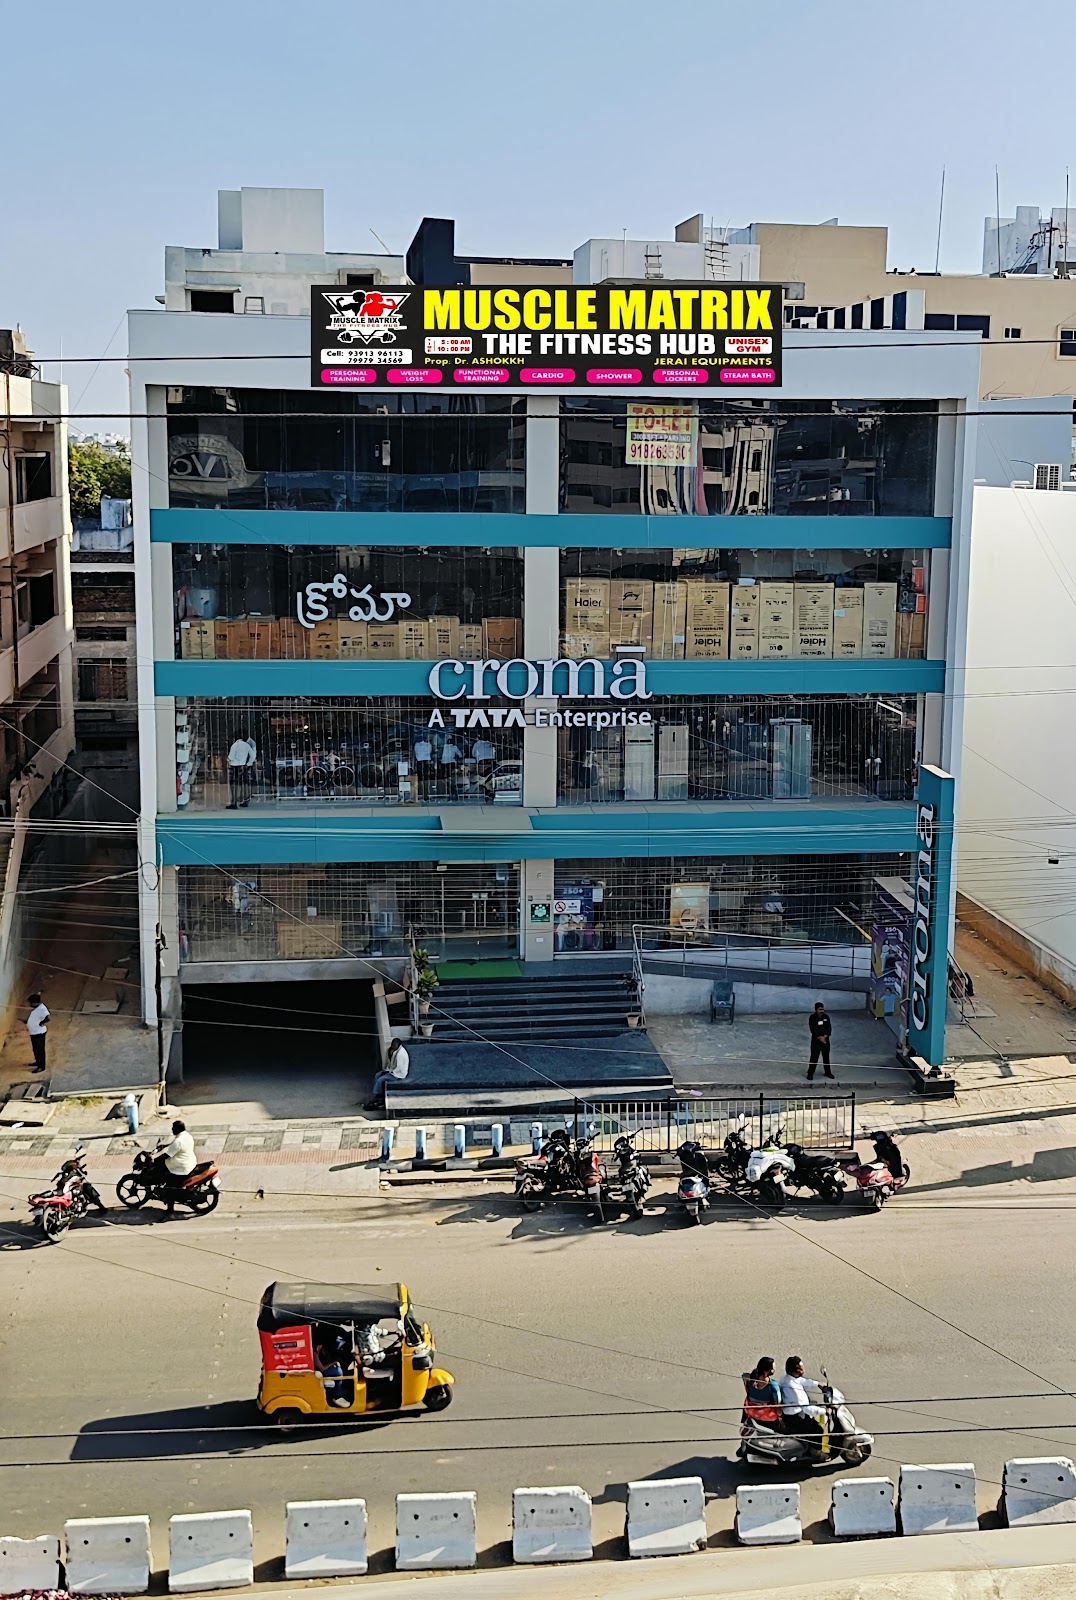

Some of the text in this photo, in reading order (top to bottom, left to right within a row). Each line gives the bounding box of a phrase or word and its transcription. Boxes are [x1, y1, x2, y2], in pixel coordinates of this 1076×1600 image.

[423, 289, 774, 331] MUSCLE MATRIX
[481, 333, 716, 355] THE FITNESS HUB
[736, 345, 761, 353] GYM
[454, 357, 469, 365] Dr.
[471, 357, 525, 365] ASHOKKH
[653, 357, 773, 367] JERAI EQUIPMENTS
[595, 372, 633, 380] SHOWER
[633, 407, 692, 431] TO-LET
[574, 597, 602, 607] Haier
[428, 707, 652, 731] A TATA Enterprise
